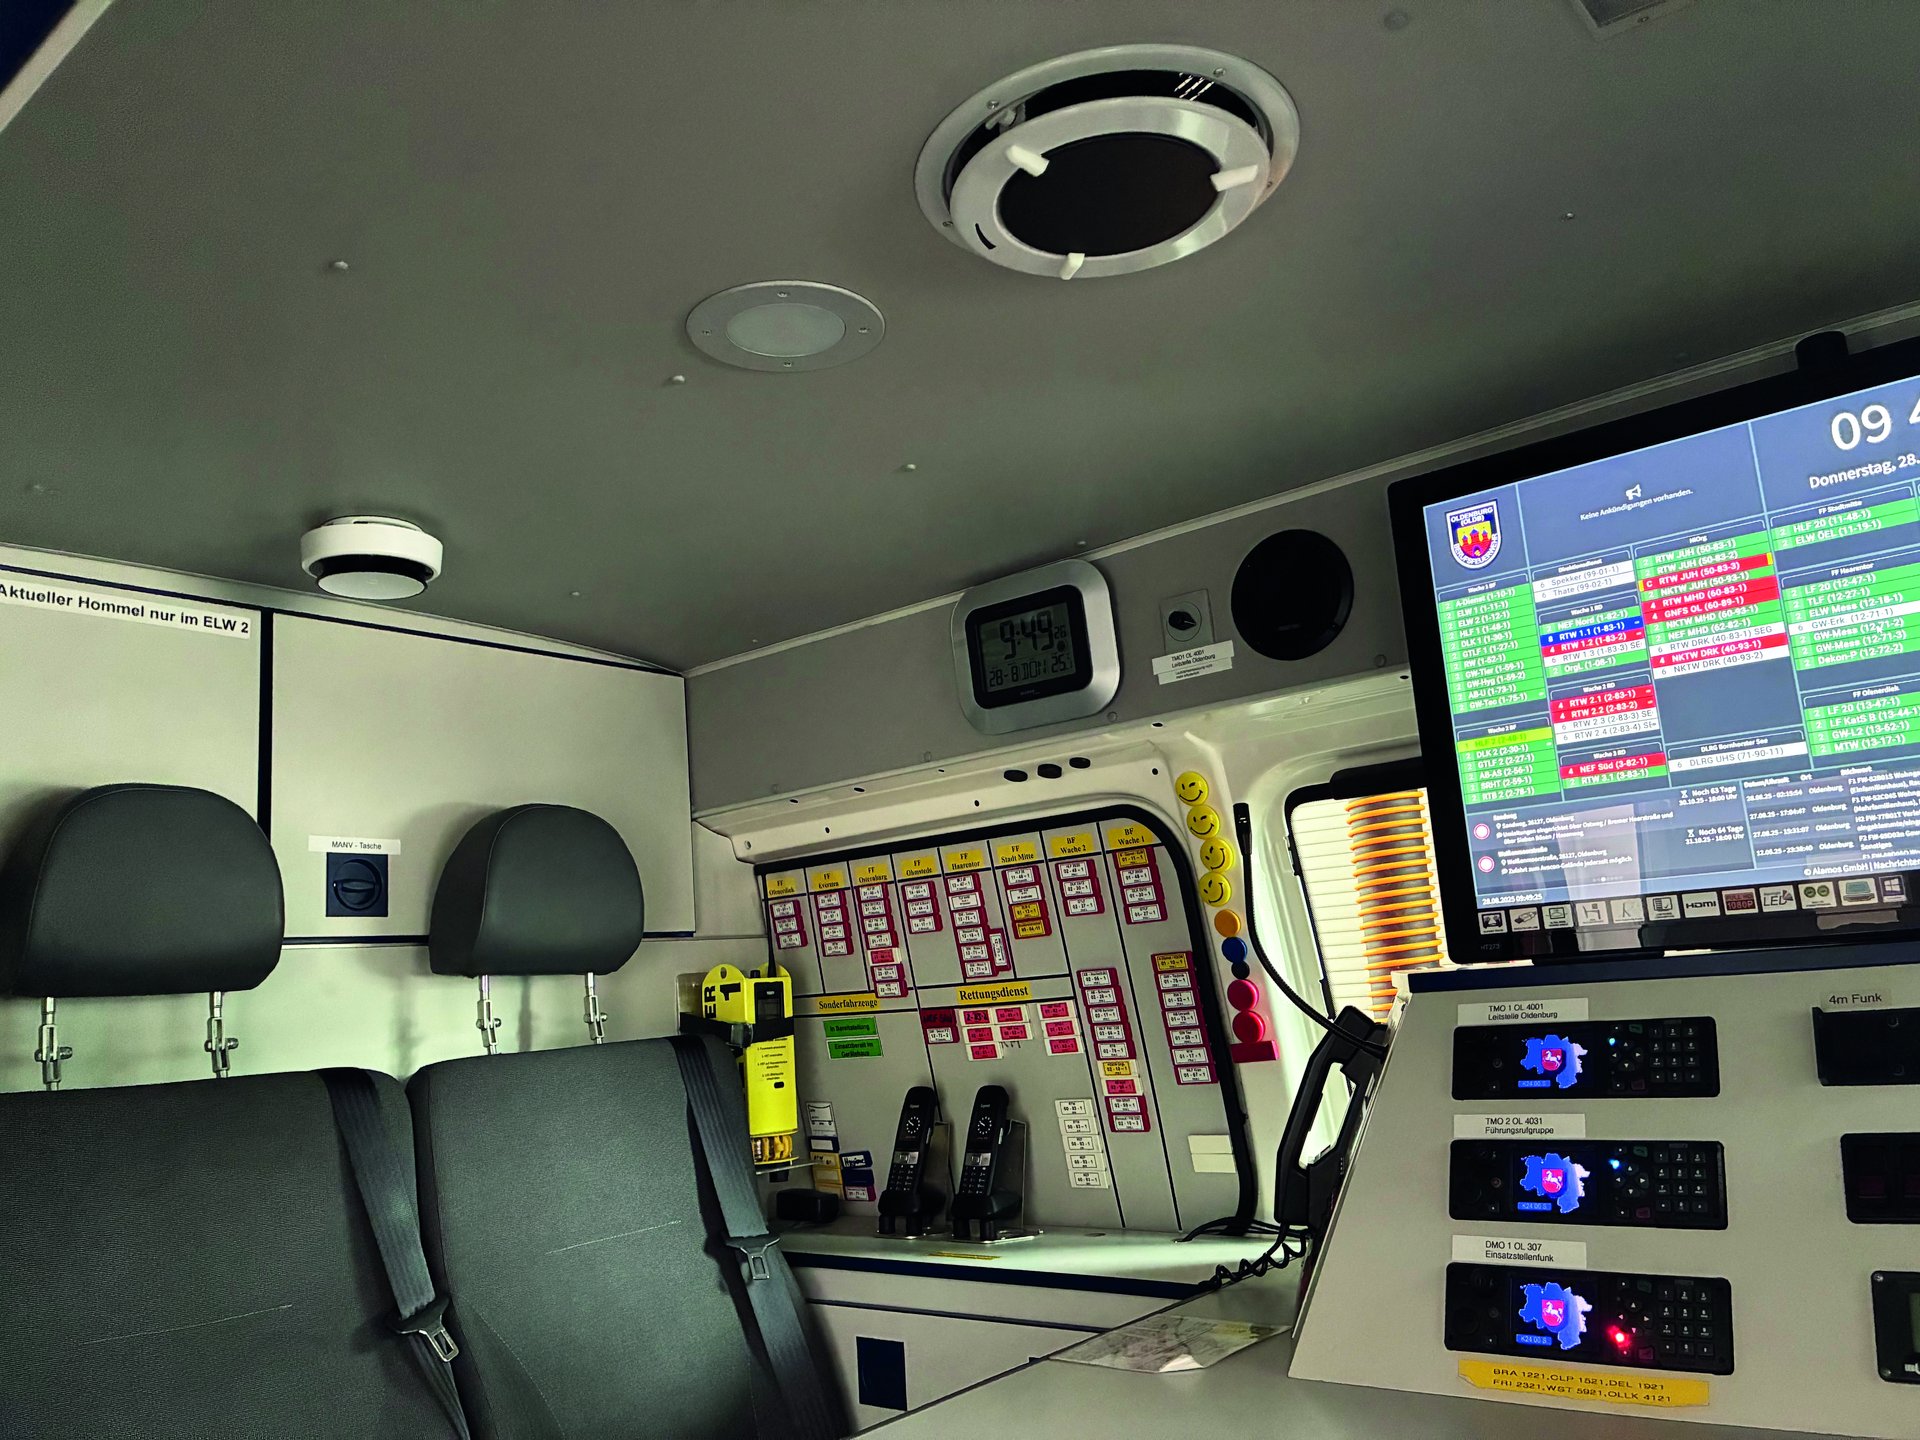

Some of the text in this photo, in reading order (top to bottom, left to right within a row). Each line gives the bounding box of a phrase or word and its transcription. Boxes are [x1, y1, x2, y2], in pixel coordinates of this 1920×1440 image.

[1831, 405, 1892, 450] 09
[1809, 460, 1897, 489] Donnerstag,
[1580, 511, 1599, 520] Keine
[1653, 488, 1693, 502] vorhanden.
[1450, 506, 1493, 523] OLDENBURG
[1793, 523, 1812, 533] HLF
[1796, 534, 1815, 544] ELW
[1656, 554, 1675, 563] RTW
[1677, 549, 1694, 557] JUH
[1552, 566, 1619, 587] Spekker (99-01-1)
[1659, 562, 1740, 585] RTW JUH (50-83-3)
[1553, 579, 1612, 596] Thate (99-02-1)
[1661, 585, 1686, 597] NKTW
[1688, 578, 1707, 588] JUH
[1805, 586, 1816, 594] LF
[1820, 584, 1830, 592] 20
[1663, 583, 1747, 607] RTW MHD (60-83-1)
[0, 584, 249, 633] Aktueller Hommel nur im ELW 2
[1665, 607, 1688, 618] GNFS
[1705, 596, 1744, 612] (60-89-1)
[1809, 607, 1828, 618] ELW
[1666, 618, 1692, 628] NKTW
[1695, 612, 1716, 624] MHD
[1000, 610, 1054, 660] 9:49
[1559, 622, 1625, 641] RTW 1.1 (1-83-1)
[1670, 641, 1689, 651] RTW
[1692, 637, 1709, 646] DRK
[1754, 626, 1772, 636] SEG
[1561, 632, 1626, 651] RTW 1.2 (1-83-2)
[1672, 640, 1761, 663] NKTW DRK (40-93-1)
[1674, 651, 1763, 673] NKTW DRK (40-93-2)
[1570, 690, 1636, 707] RTW 2.1 (2-83-1)
[1571, 701, 1637, 718] RTW 2.2 (2-83-2)
[1834, 741, 1858, 752] MTW
[1690, 747, 1783, 767] DLRG UHS (71-90-11)
[1580, 757, 1648, 773] NEF Süd (3-82-1)
[360, 842, 381, 850] Tasche
[1118, 837, 1139, 845] Wache
[1060, 846, 1081, 854] Wache
[952, 861, 980, 870] Haarentor
[1001, 855, 1016, 863] Stadt
[1843, 864, 1868, 872] GmbH
[1686, 901, 1716, 909] HDMI
[1728, 901, 1753, 910] 1080P
[960, 986, 1029, 1001] Rettungsdienst
[1829, 993, 1882, 1004] 4m Funk
[819, 999, 877, 1010] Sonderfahrzeuge
[1489, 1004, 1506, 1012] TMO
[1514, 1004, 1524, 1012] OL
[1526, 1003, 1544, 1011] 4001
[1488, 1011, 1557, 1021] Leitstelle Oldenburg
[1485, 1117, 1543, 1126] TMO 2 OL 4031
[1485, 1126, 1554, 1135] Führungsrufgruppe
[1485, 1240, 1505, 1250] DMO
[1514, 1242, 1526, 1251] OL
[1527, 1242, 1542, 1251] 307
[1485, 1250, 1554, 1262] Einsatzstellenfunk
[1493, 1369, 1518, 1378] BRA
